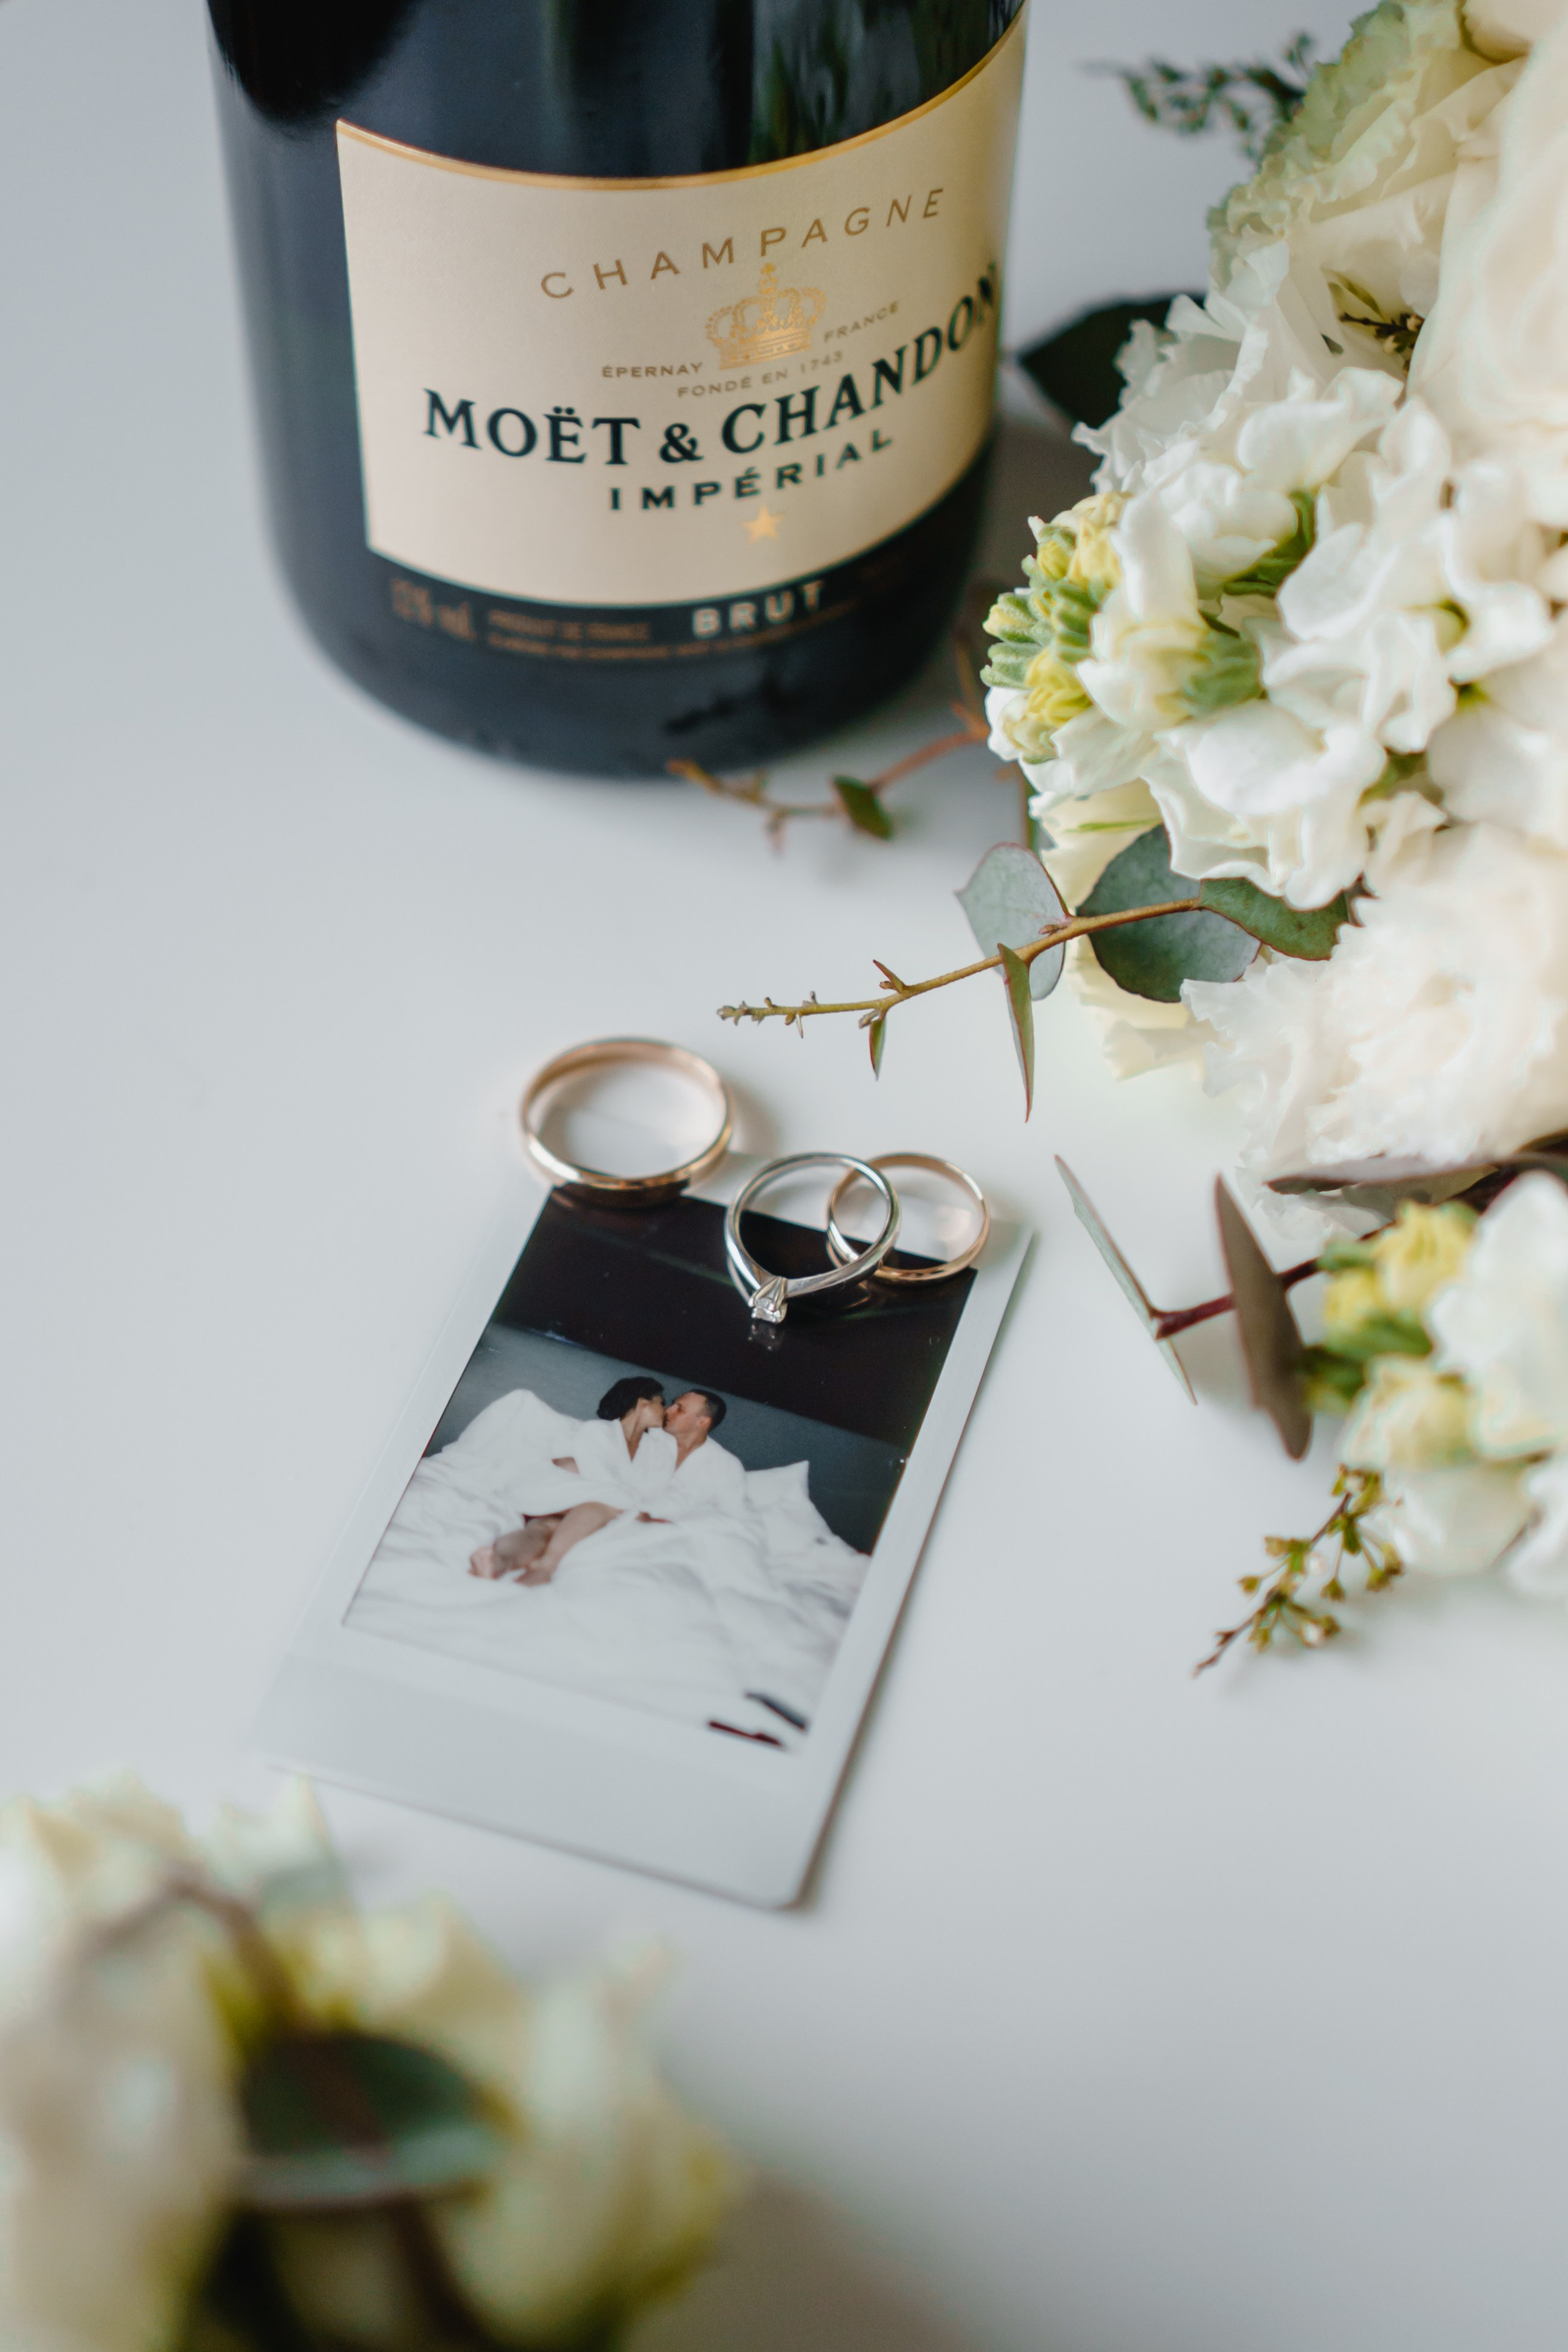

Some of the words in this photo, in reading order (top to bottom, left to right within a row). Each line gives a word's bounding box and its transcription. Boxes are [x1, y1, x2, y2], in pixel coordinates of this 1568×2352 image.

[540, 187, 944, 299] CHAMPAGNE
[423, 388, 641, 465] MOËT
[658, 423, 704, 463] &
[722, 260, 997, 454] CHANDON
[602, 361, 703, 379] ÉPERNAY
[823, 300, 899, 343] FRANCE
[677, 375, 752, 398] FONDÉ
[761, 368, 789, 385] EN
[797, 350, 844, 375] 1743
[609, 429, 892, 511] IMPÉRIAL
[692, 579, 823, 638] BRUT
